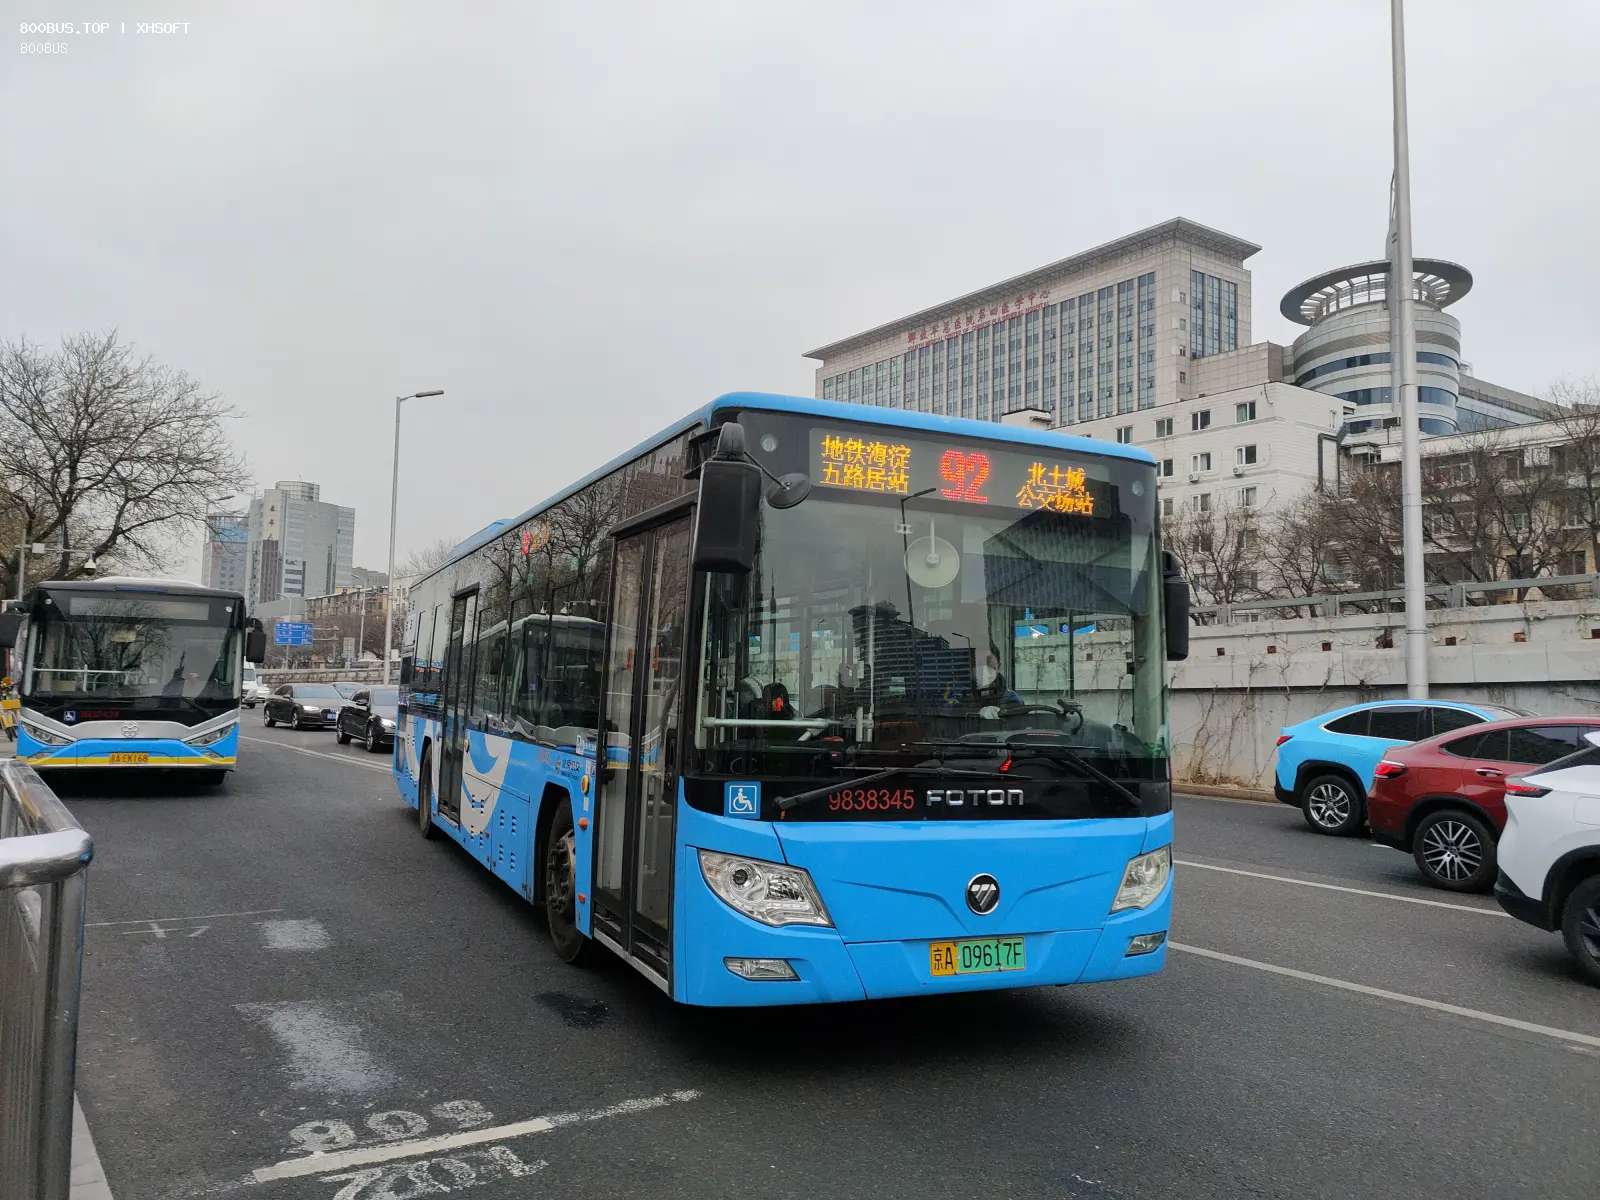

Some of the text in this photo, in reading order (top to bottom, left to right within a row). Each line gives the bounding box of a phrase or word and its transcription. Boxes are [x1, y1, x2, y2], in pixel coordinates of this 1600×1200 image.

[820, 434, 911, 469] 地铁海淀
[819, 461, 910, 495] 五路居站
[939, 450, 990, 503] 92
[1026, 461, 1086, 492] 北土城
[1015, 480, 1094, 516] 公交场站
[828, 789, 1024, 811] 9838345 FOTON
